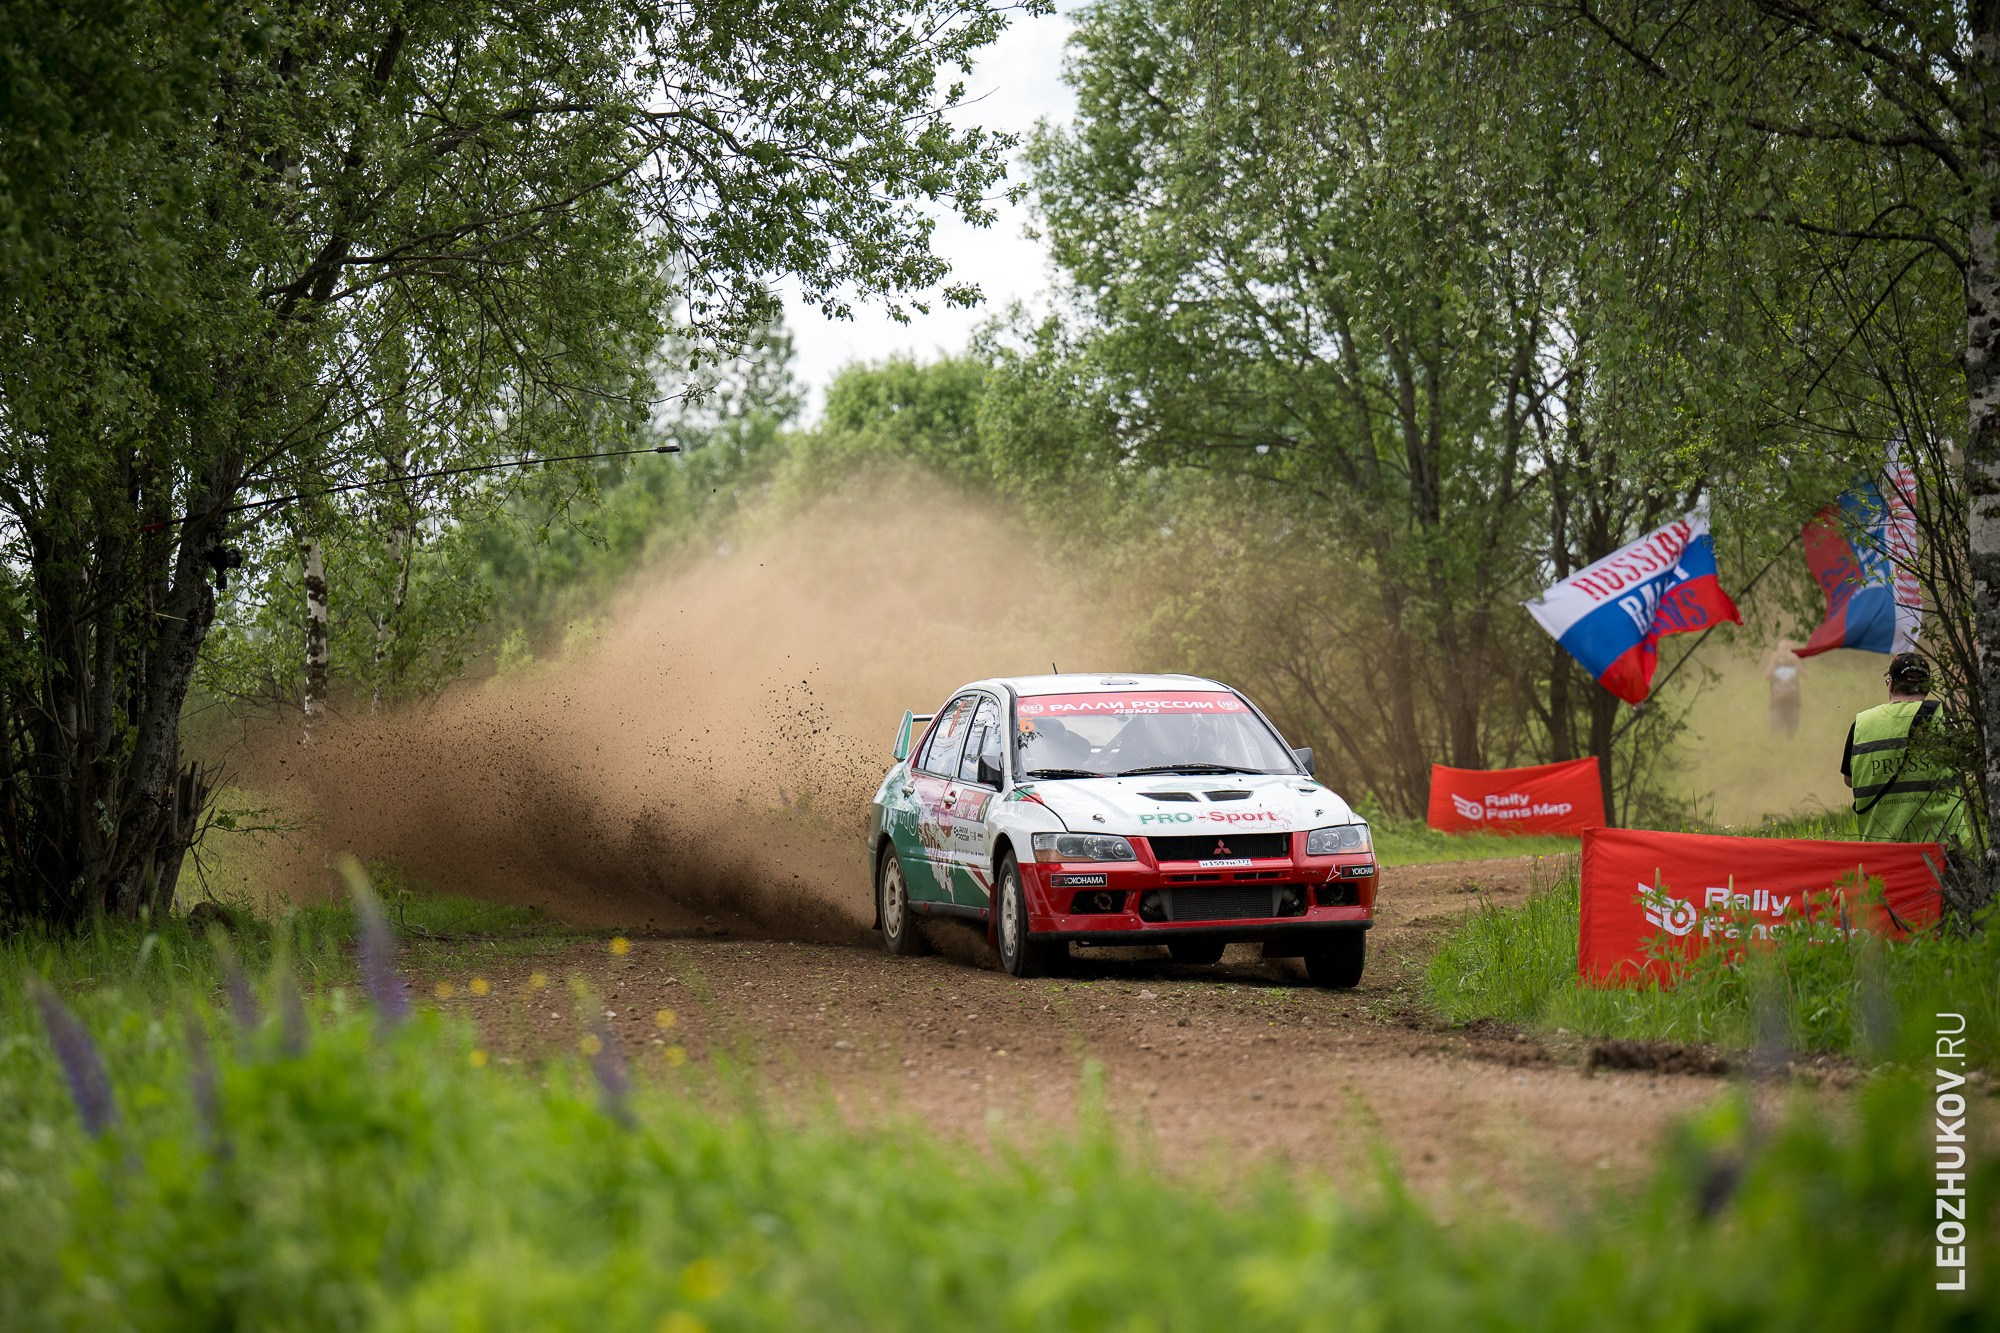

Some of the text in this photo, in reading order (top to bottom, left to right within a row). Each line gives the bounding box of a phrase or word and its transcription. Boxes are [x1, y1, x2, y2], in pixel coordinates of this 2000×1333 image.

[1049, 701, 1124, 712] РАЛЛИ
[1131, 700, 1214, 709] РОССИИ
[1018, 717, 1034, 732] 6
[1484, 793, 1530, 807] Rally
[1486, 803, 1572, 819] Fans Map
[1064, 876, 1104, 884] YOKOHAMA
[1704, 887, 1791, 917] Rally
